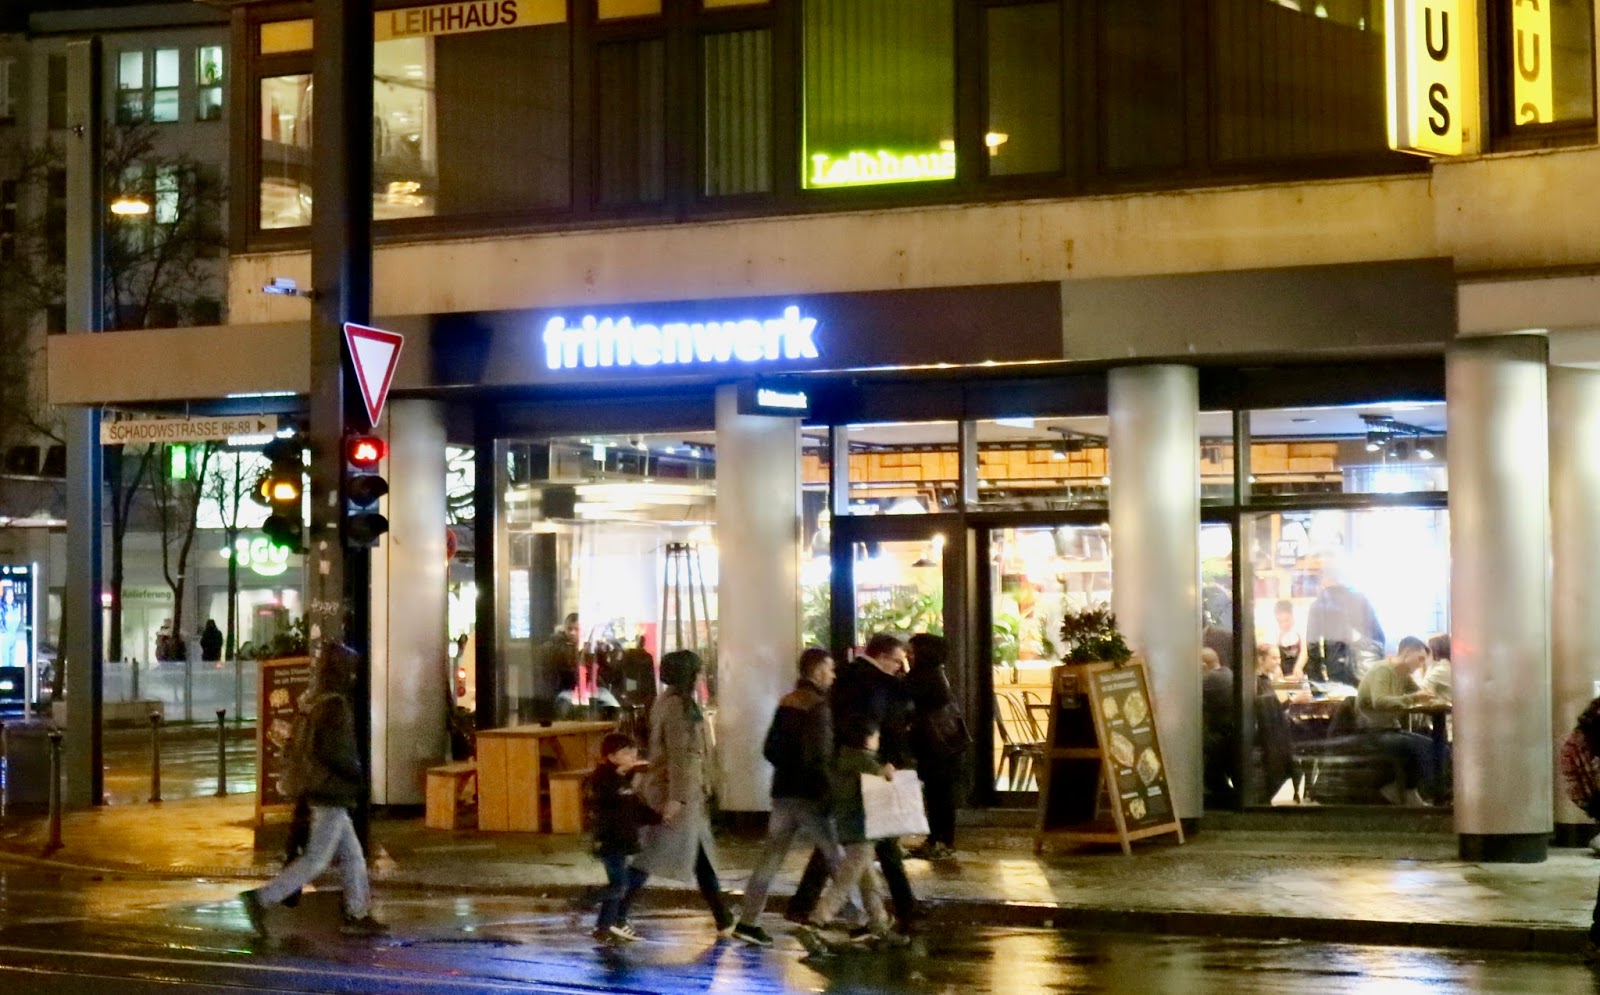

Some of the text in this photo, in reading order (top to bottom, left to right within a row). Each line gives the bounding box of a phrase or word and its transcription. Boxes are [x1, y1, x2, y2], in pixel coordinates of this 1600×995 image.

[391, 0, 518, 37] LEIHHAUS
[543, 305, 819, 369] frittenwerk
[109, 420, 251, 440] SCHADOWSTRASSE 86-88
[122, 589, 172, 601] Anlieferung
